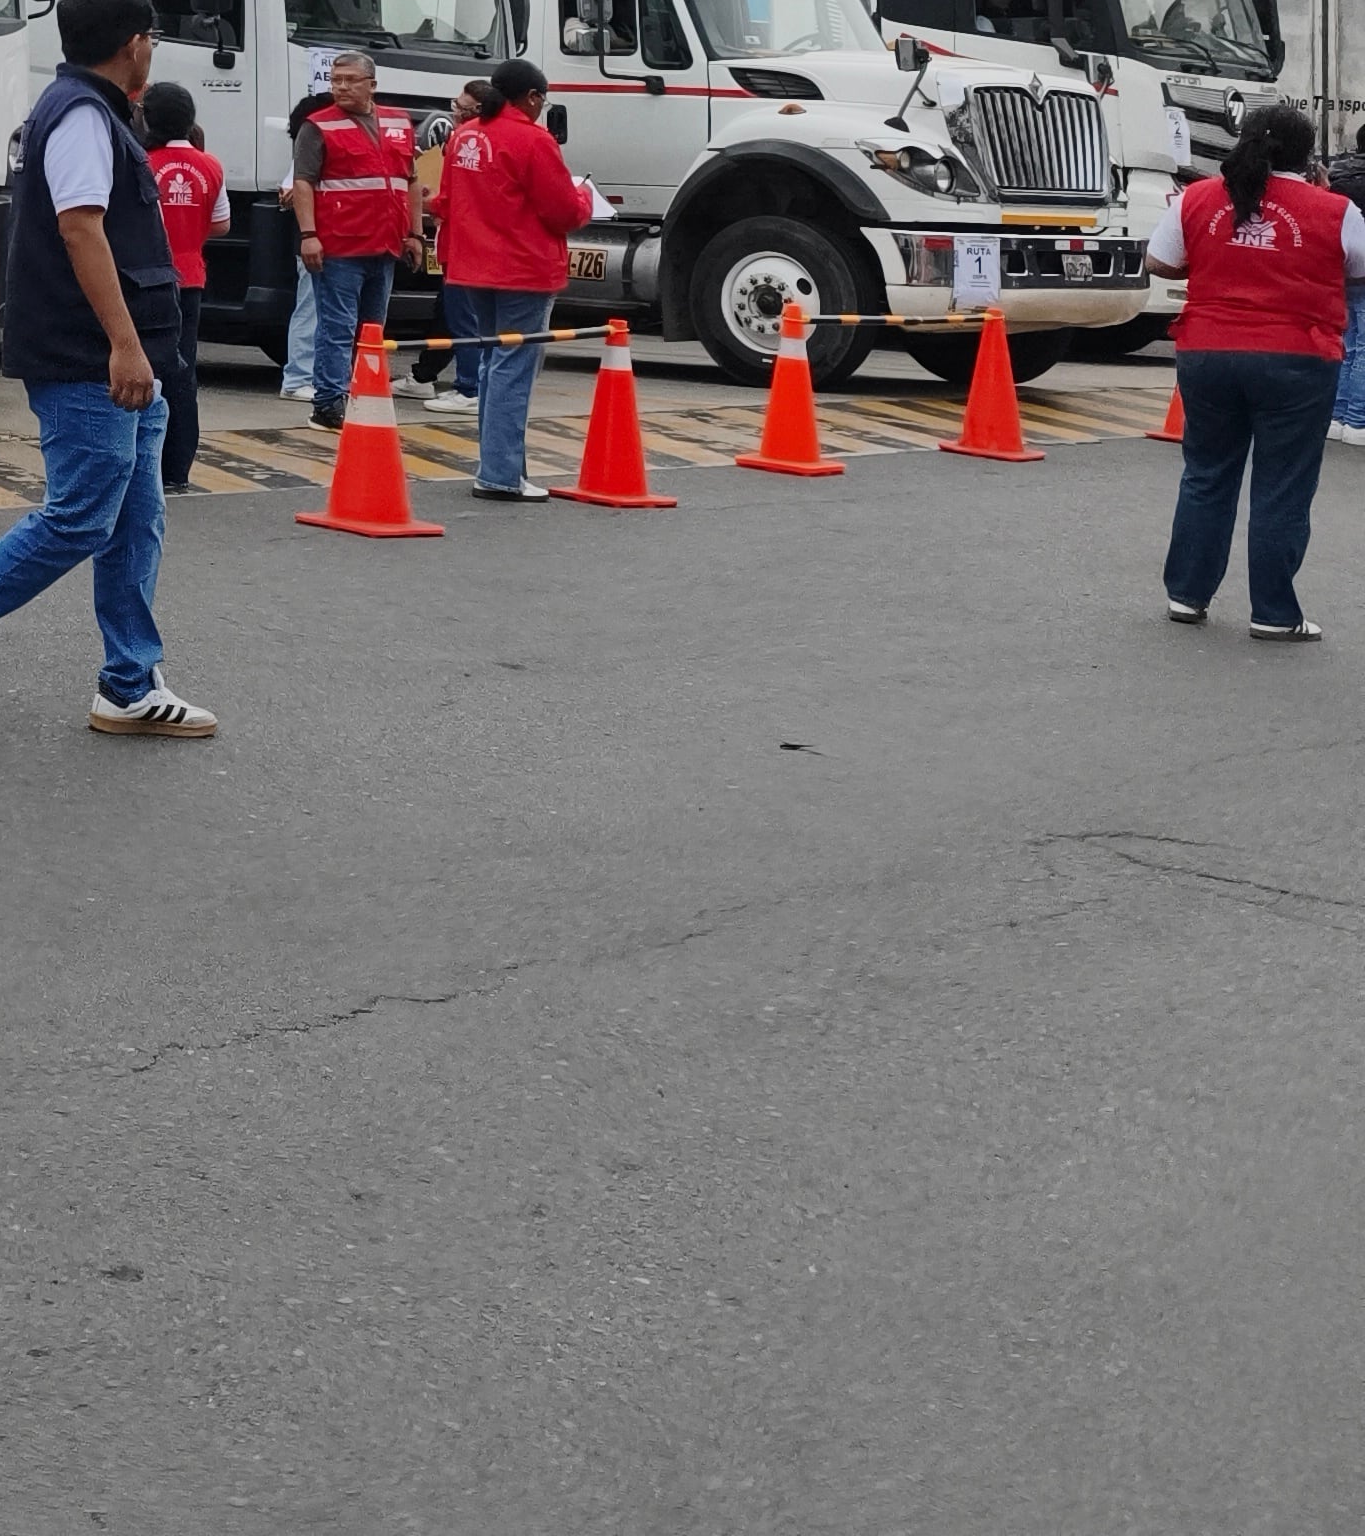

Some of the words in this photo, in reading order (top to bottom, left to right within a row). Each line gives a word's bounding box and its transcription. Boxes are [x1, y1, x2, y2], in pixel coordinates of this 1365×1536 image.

[1166, 75, 1202, 86] FOTON
[1173, 121, 1181, 135] 2
[456, 157, 480, 170] JNE
[168, 193, 193, 204] JNE
[1231, 233, 1276, 248] JNE
[966, 247, 992, 256] RUTA
[974, 256, 982, 274] 1
